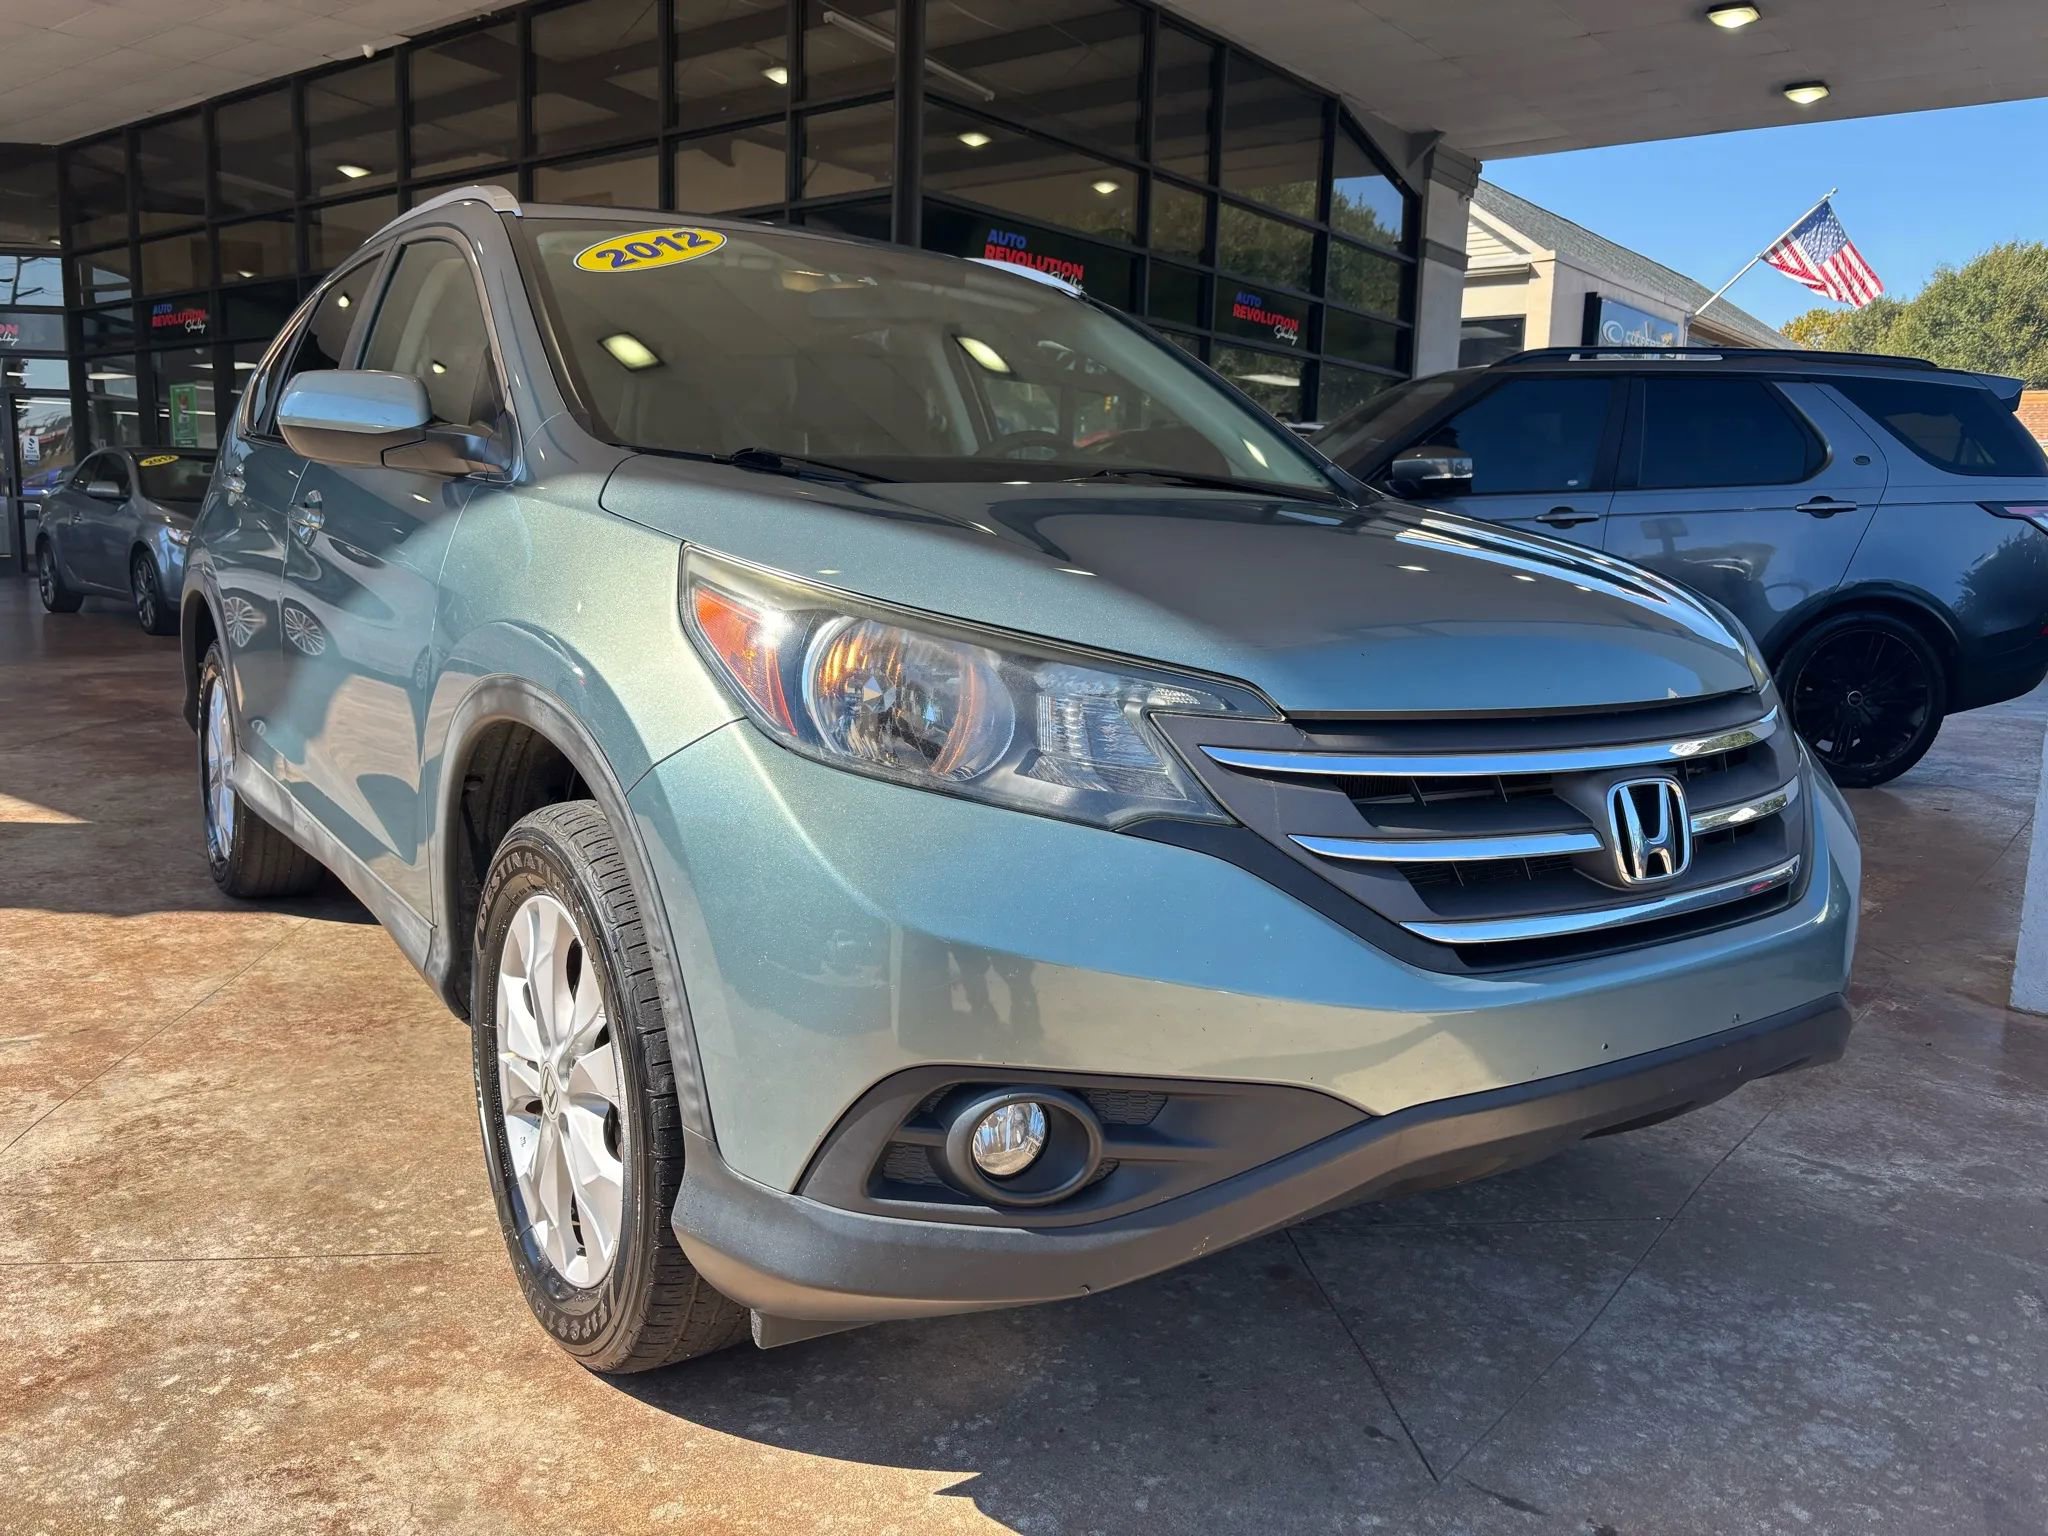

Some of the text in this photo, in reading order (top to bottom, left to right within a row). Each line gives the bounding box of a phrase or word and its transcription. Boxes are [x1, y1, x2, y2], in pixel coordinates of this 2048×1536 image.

[987, 228, 1026, 249] AUTO
[596, 231, 715, 269] 2012
[984, 243, 1085, 281] REVOLUTION
[152, 303, 172, 315] AUTO
[1235, 291, 1262, 308] AUTO
[152, 309, 206, 328] REVOLUTION
[1232, 303, 1299, 332] REVOLUTION
